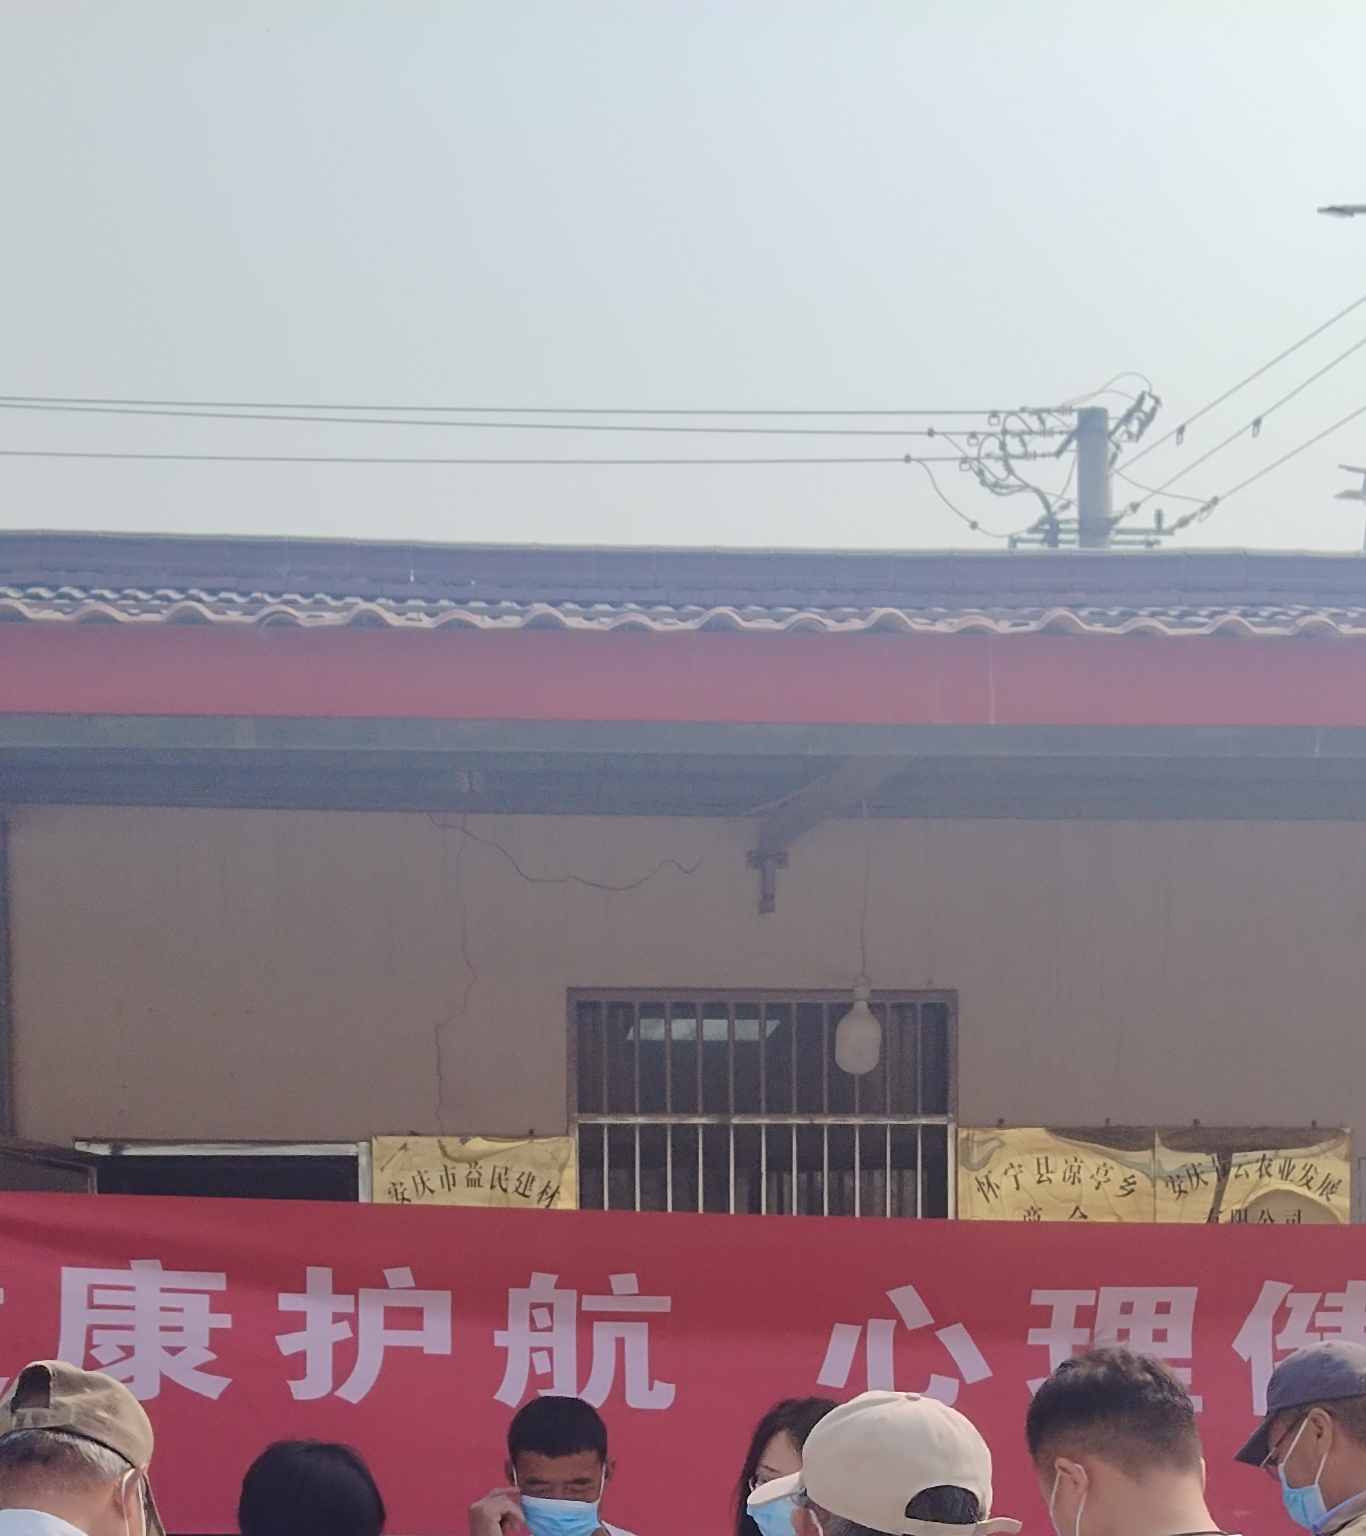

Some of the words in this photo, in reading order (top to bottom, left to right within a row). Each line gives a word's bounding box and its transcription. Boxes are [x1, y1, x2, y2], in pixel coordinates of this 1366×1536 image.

[387, 1161, 561, 1209] 安庆市益民建材
[974, 1156, 1137, 1204] 怀宁县凉亭乡
